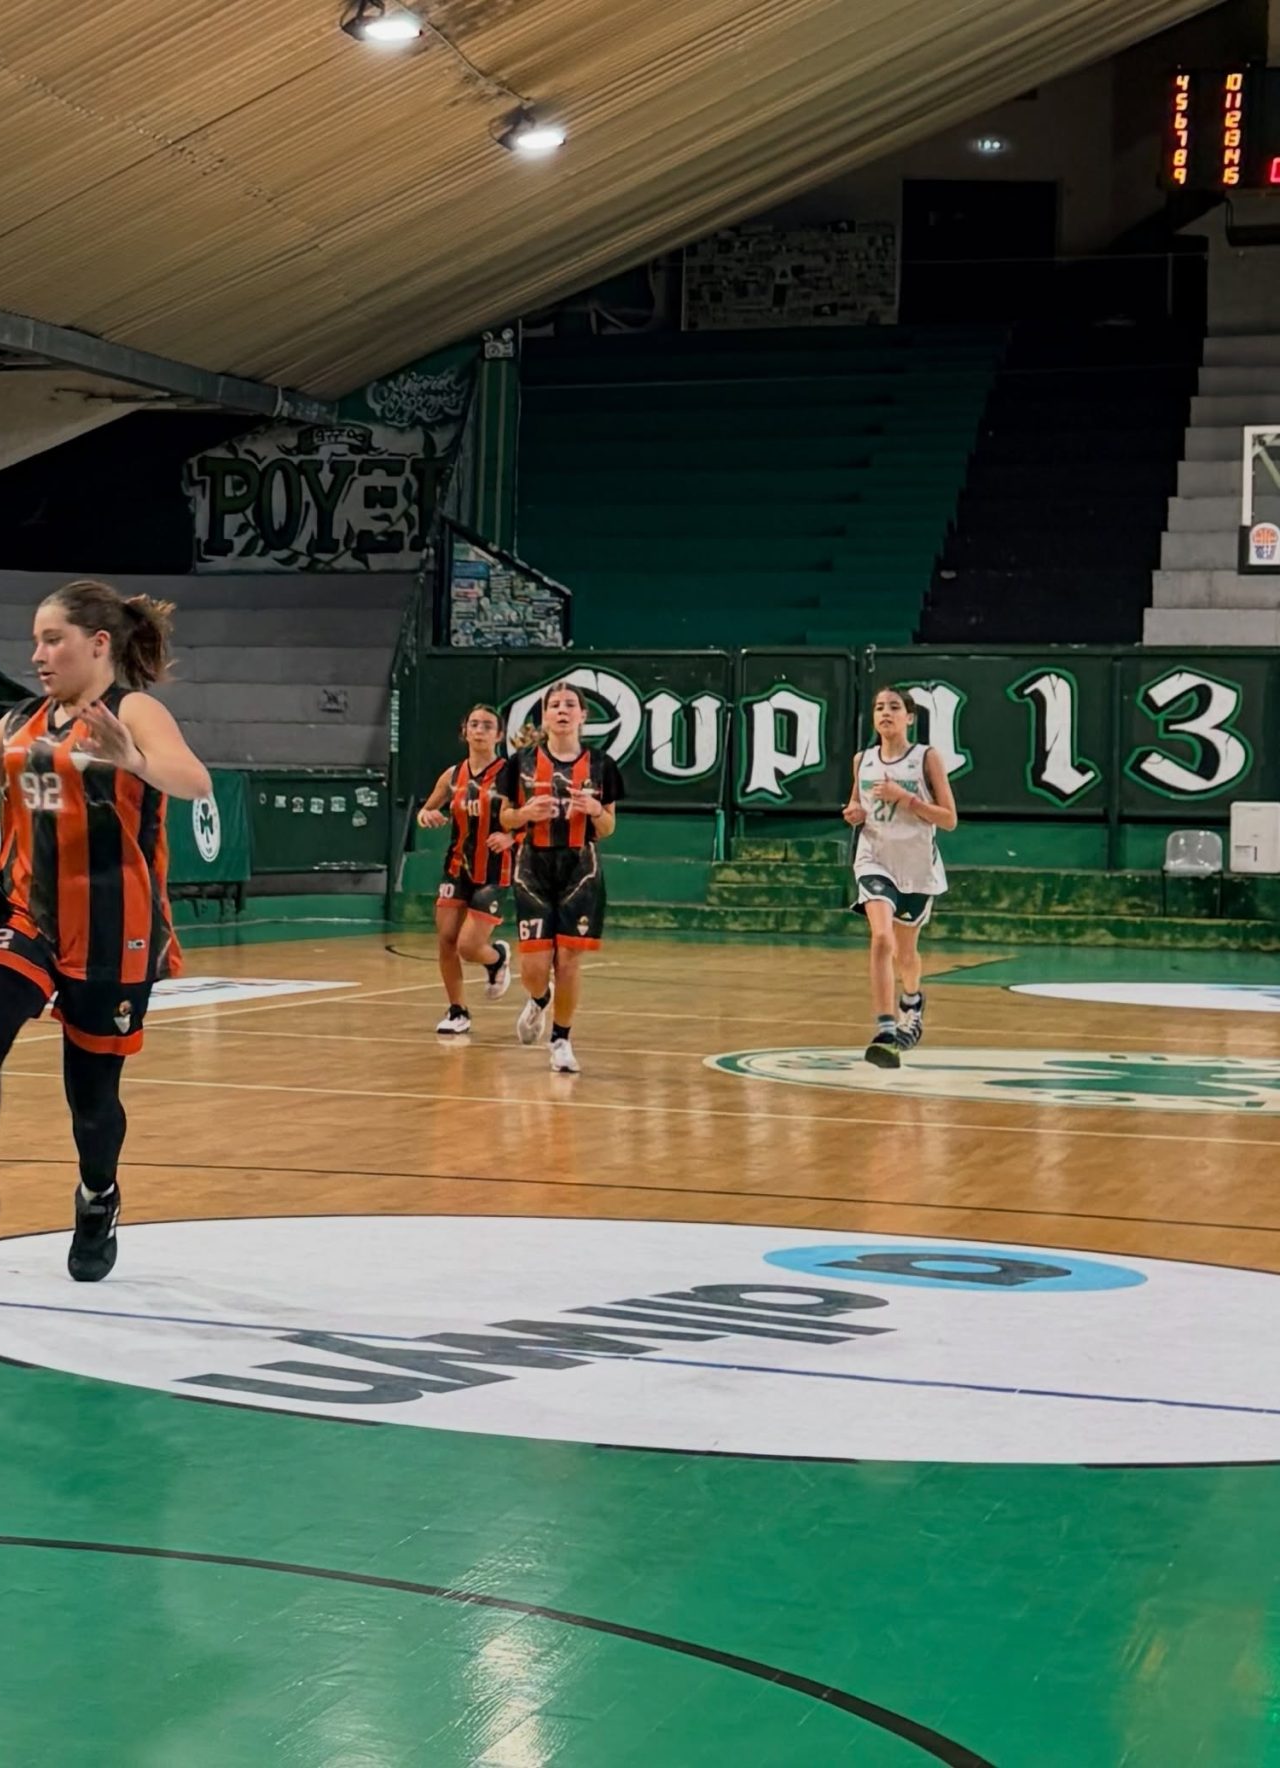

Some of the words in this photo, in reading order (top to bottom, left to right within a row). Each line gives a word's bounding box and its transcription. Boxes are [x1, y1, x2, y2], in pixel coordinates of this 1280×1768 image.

[1176, 75, 1190, 91] 4
[1226, 73, 1243, 91] 10
[1175, 92, 1188, 111] 5
[1225, 92, 1242, 108] 11
[1174, 112, 1188, 129] 6
[1176, 130, 1188, 147] 7
[1224, 129, 1241, 147] 13
[1173, 149, 1187, 166] 8
[1173, 168, 1187, 184] 9
[1223, 166, 1239, 184] 15
[1014, 668, 1250, 801] 13
[20, 772, 63, 810] 92
[873, 799, 900, 822] 27
[519, 918, 544, 940] 67
